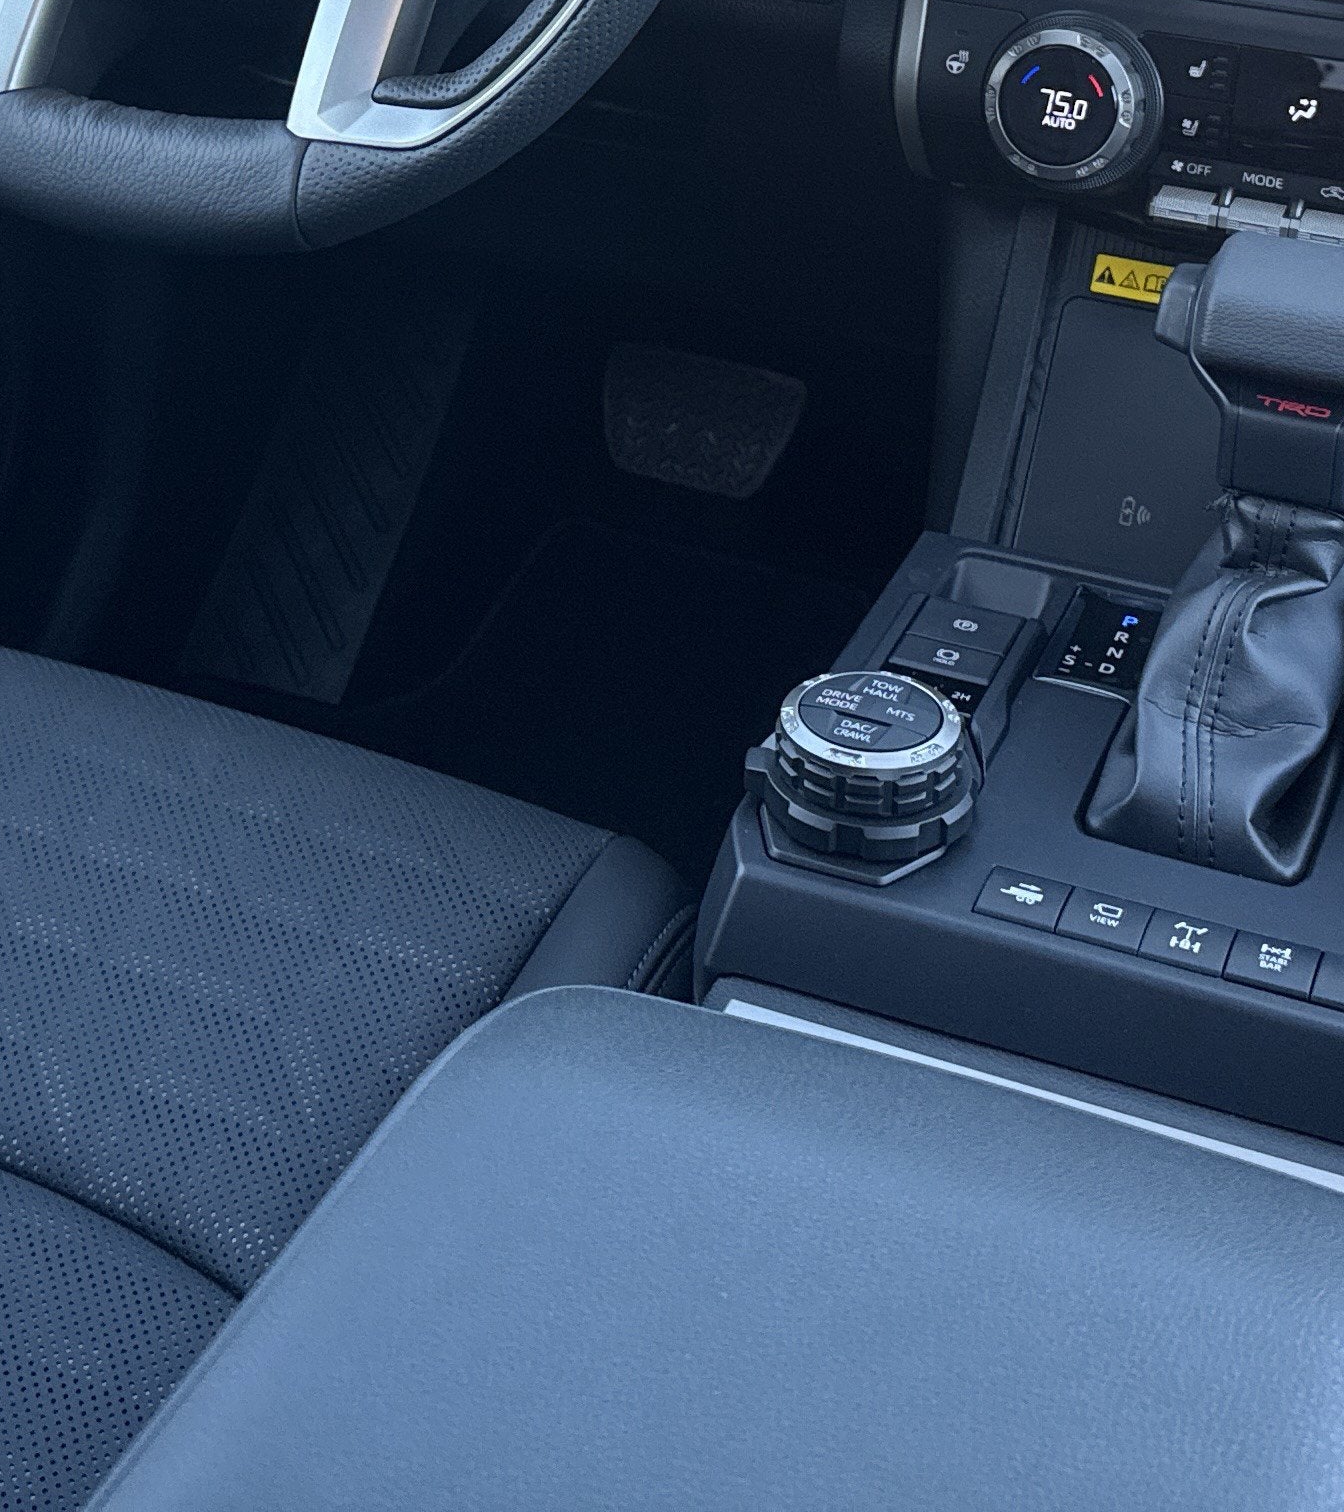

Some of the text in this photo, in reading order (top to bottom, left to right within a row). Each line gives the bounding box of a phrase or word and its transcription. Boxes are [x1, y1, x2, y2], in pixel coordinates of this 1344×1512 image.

[1040, 88, 1089, 121] 75.0
[1042, 115, 1076, 131] AUTO
[1186, 163, 1212, 177] OFF
[1242, 171, 1284, 190] MODE
[1256, 394, 1332, 418] TRD
[1121, 615, 1139, 627] P
[1113, 630, 1129, 644] R
[1062, 654, 1077, 666] S
[1106, 646, 1124, 659] N
[1098, 662, 1116, 675] D
[871, 679, 904, 694] TOW
[821, 688, 863, 703] DRIVE
[862, 686, 900, 703] HAUL
[951, 691, 972, 702] 2H
[815, 696, 858, 711] MODE
[886, 706, 916, 723] MTS
[833, 727, 872, 744] CRAWL
[1089, 913, 1120, 928] VIEW
